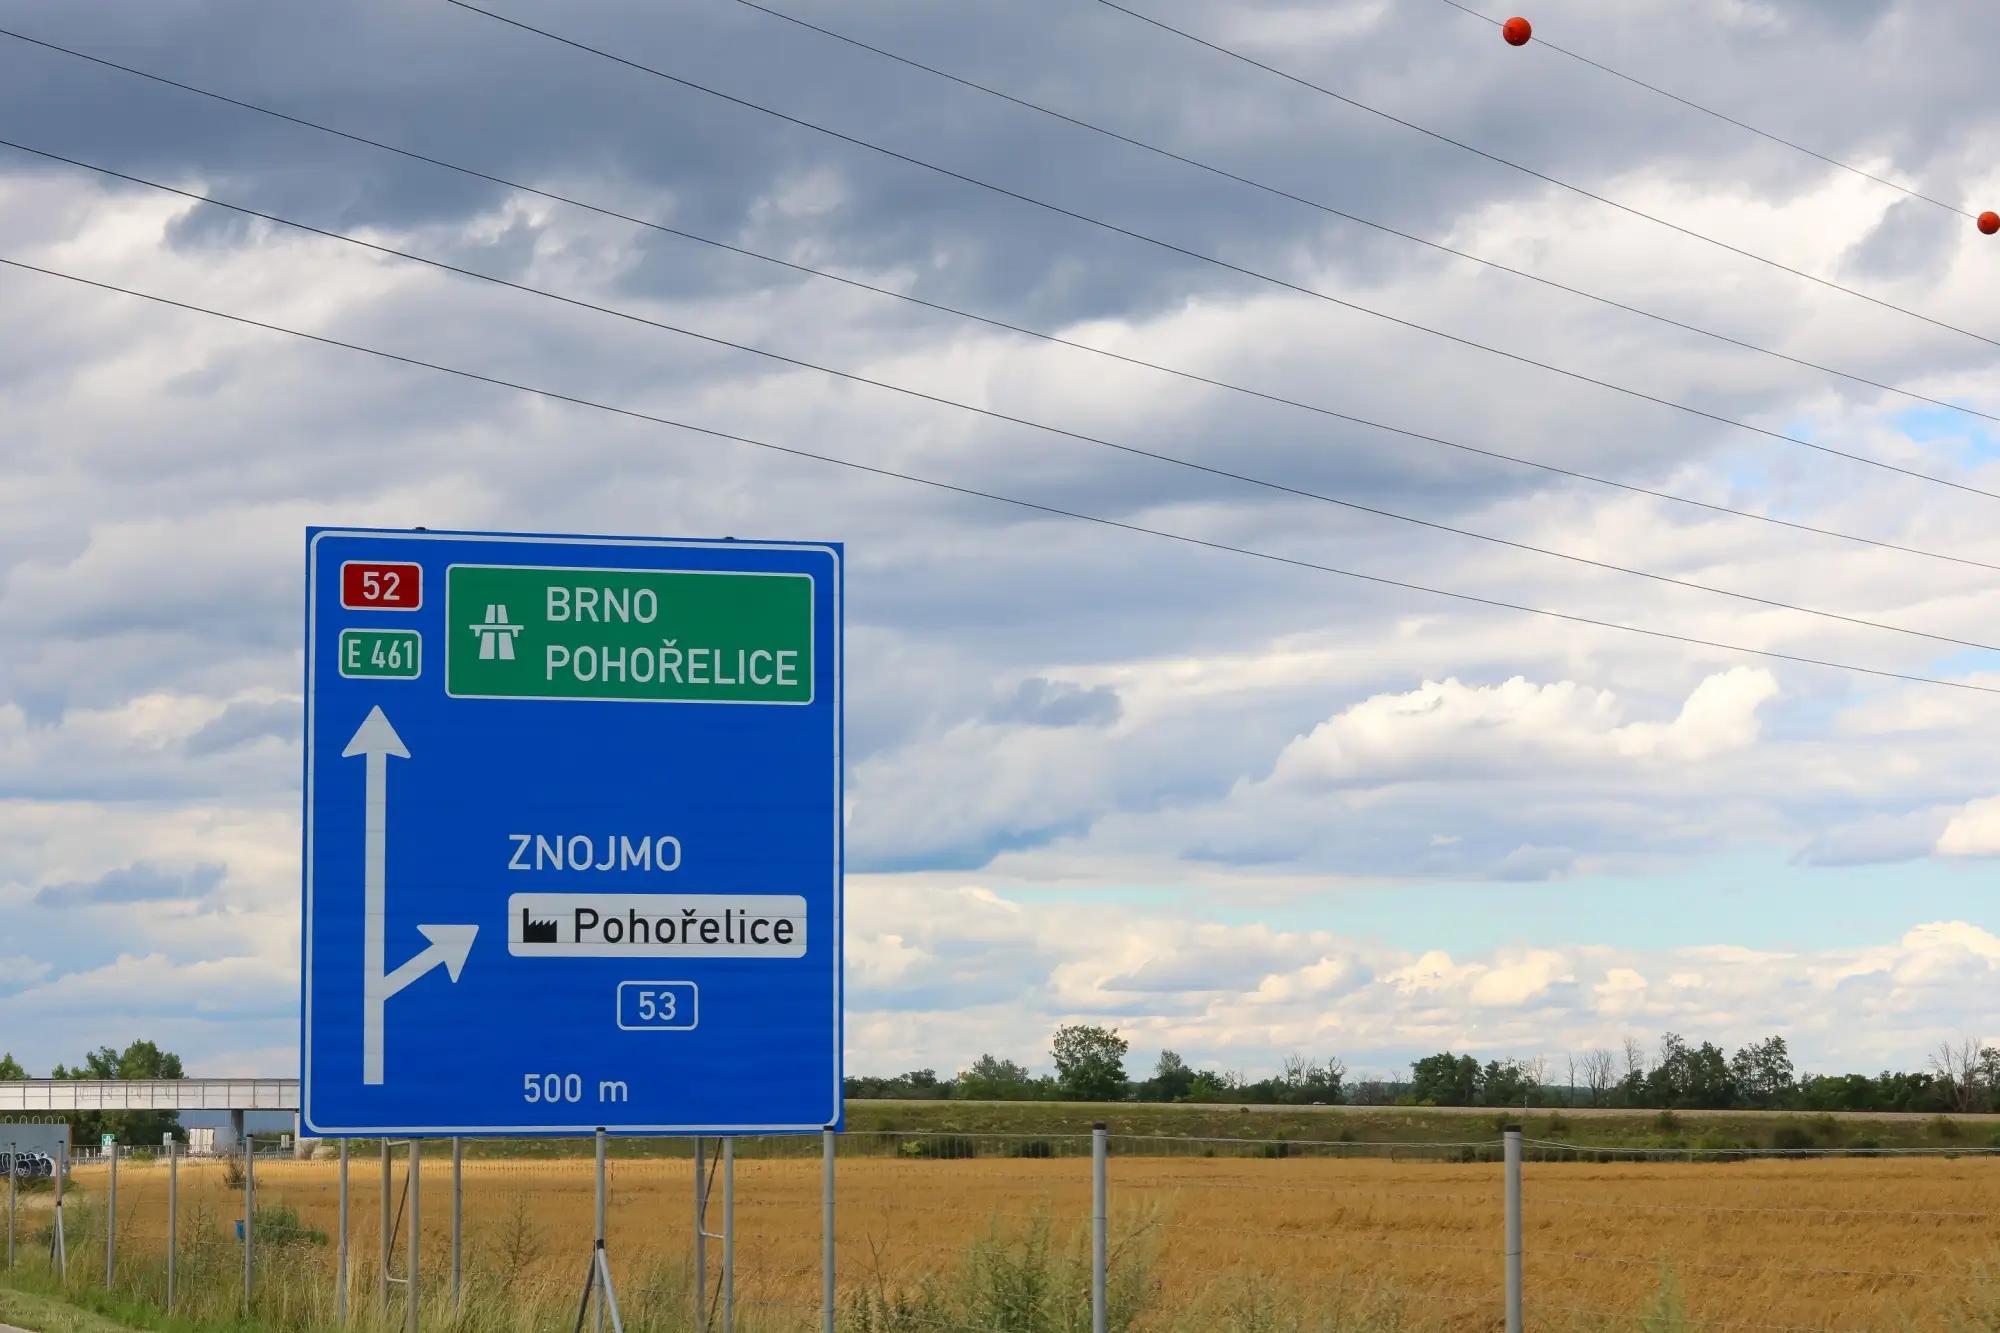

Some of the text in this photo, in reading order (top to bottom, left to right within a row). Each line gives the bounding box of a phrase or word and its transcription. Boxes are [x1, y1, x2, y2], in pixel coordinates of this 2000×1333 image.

[363, 571, 401, 601] 52
[546, 586, 658, 624] BRNO
[347, 639, 414, 669] E 461
[546, 638, 798, 686] POHOŘELICE
[508, 834, 682, 872] ZNOJMO
[574, 908, 794, 945] Pohořelice
[638, 991, 676, 1020] 53
[523, 1073, 628, 1103] 500 m
